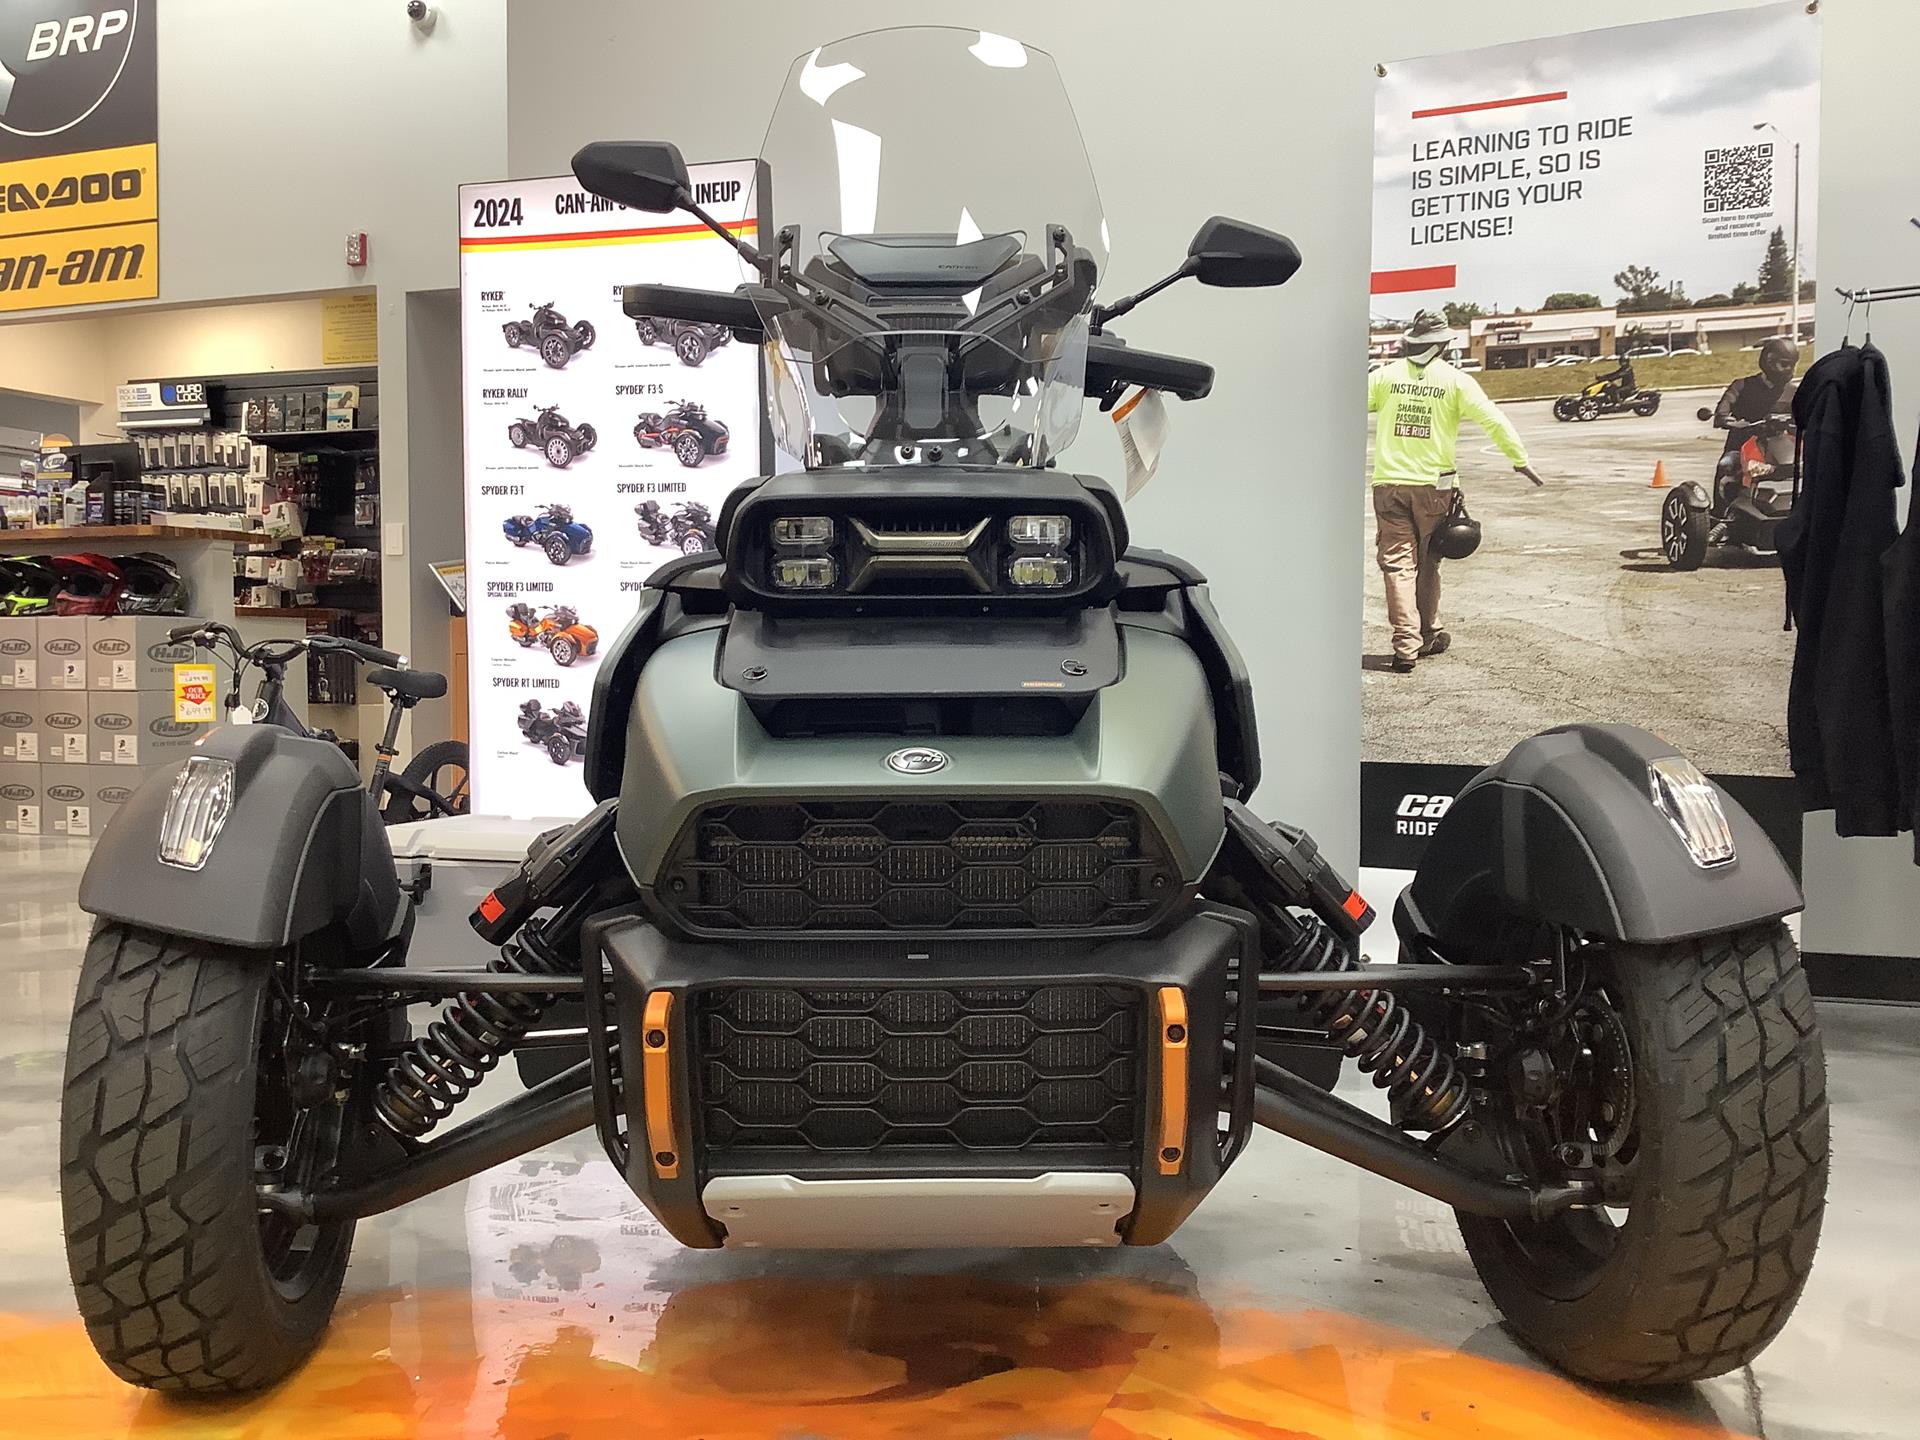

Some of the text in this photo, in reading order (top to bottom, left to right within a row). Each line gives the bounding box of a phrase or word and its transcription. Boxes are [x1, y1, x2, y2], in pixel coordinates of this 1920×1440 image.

[26, 9, 128, 62] BRP
[1412, 116, 1633, 162] LEARNING TO RIDE
[1412, 149, 1601, 190] IS SIMPLE, SO IS
[473, 198, 524, 228] 2024
[695, 181, 742, 205] INEUP
[1411, 180, 1583, 218] GETTING YOUR
[1410, 216, 1513, 246] LICENSE!
[481, 291, 504, 301] RYKER
[175, 384, 202, 394] QUAD
[482, 388, 529, 399] RYKER RALLY
[615, 384, 644, 396] SPYDER
[1390, 383, 1446, 399] INSTRUCTOR
[176, 392, 204, 403] LOCK
[1397, 403, 1427, 414] SHARING
[1396, 424, 1430, 437] THE RIDE
[481, 485, 509, 496] SPYDER
[617, 482, 687, 494] SPYDER F3 LIMITED
[487, 582, 553, 592] SPYDER F3 LIMITED
[620, 582, 643, 592] SPYDE
[154, 647, 190, 659] HJC
[493, 677, 520, 688] SPYDER
[532, 678, 560, 689] LIMITED
